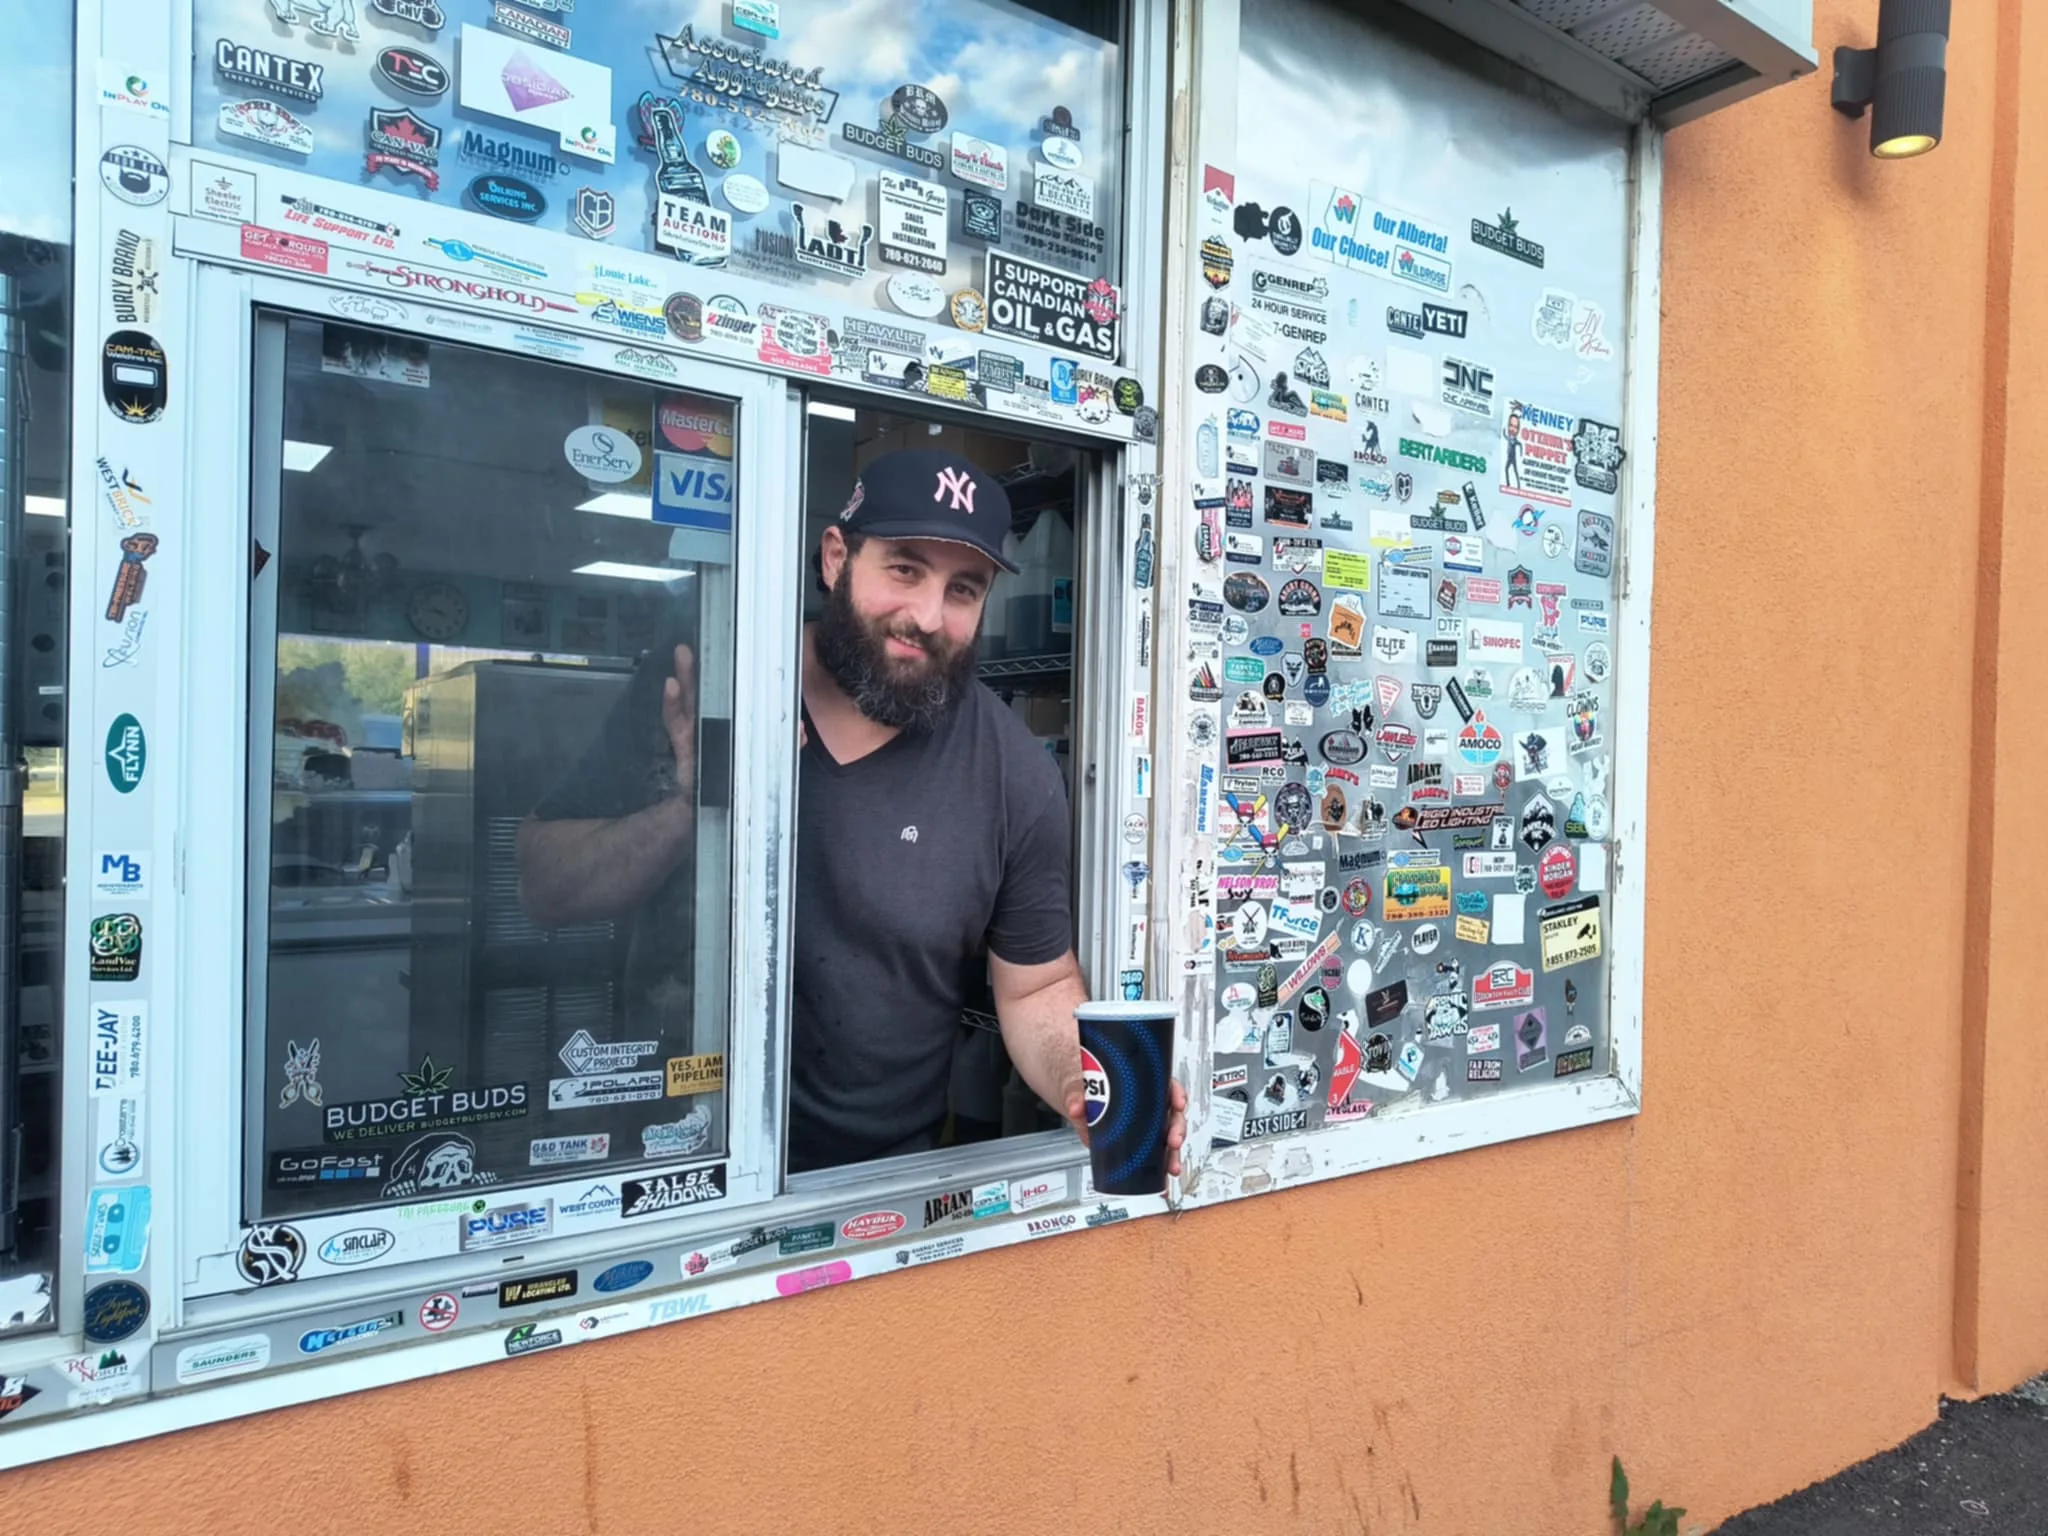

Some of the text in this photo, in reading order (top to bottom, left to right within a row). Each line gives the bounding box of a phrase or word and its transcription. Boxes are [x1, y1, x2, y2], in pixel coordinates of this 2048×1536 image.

[498, 6, 568, 41] CANADIAN
[219, 39, 323, 94] CANTEX
[672, 24, 825, 90] Associated
[464, 130, 556, 173] Magnum
[845, 126, 902, 153] BUDGET
[906, 145, 943, 169] BUDS
[882, 177, 897, 189] The
[205, 196, 241, 210] Electric
[662, 201, 727, 235] TEAM
[1016, 201, 1061, 228] Dark
[1068, 217, 1105, 241] Side
[284, 210, 308, 225] LIFE
[313, 215, 369, 241] SUPPORT
[372, 234, 395, 250] LTD.
[662, 218, 726, 244] AUCTIONS
[901, 222, 927, 237] SERVICE
[1017, 219, 1103, 253] Window Tinting
[1373, 211, 1448, 255] Our Alberta!
[892, 232, 936, 250] INSTALLATION
[1312, 227, 1389, 269] Our Choice!
[1473, 221, 1544, 260] BUDGET BUDS
[109, 229, 140, 324] BURLY BRAND
[994, 260, 1086, 299] I SUPPORT
[1267, 273, 1314, 292] GENREP
[386, 267, 548, 312] STRONGHOLD
[994, 280, 1085, 318] CANADIAN
[617, 310, 666, 328] WIENS
[1252, 298, 1327, 324] 24 HOUR SERVICE
[1424, 308, 1462, 334] YETI
[715, 314, 756, 334] zinger
[844, 320, 923, 347] HEAVYLIFT
[992, 298, 1113, 353] OIL & GAS
[1273, 322, 1327, 344] 7-GENREP
[105, 343, 163, 358] CAM-TAC
[1355, 392, 1390, 413] CANTEX
[1522, 406, 1574, 432] KENNEY
[572, 448, 634, 470] EnerServ
[1354, 450, 1387, 464] BRONCO
[1525, 443, 1568, 464] PUPPET
[671, 469, 732, 504] VIS
[934, 467, 977, 514] NY
[1413, 519, 1467, 532] BUDGET BUDS
[1438, 618, 1461, 631] DTF
[1376, 637, 1406, 649] ELITE
[1483, 636, 1521, 649] SINOPEC
[1376, 729, 1417, 744] LAWLESS
[1459, 738, 1501, 749] AMOCO
[125, 726, 140, 782] FLYNN
[1262, 767, 1285, 776] RCO
[1422, 809, 1449, 818] RIGID
[1440, 816, 1490, 828] LIGHTING
[1339, 850, 1382, 869] Magnum
[1414, 930, 1438, 944] PLAYER
[91, 956, 137, 967] LandVac
[1287, 945, 1327, 990] WILLOWS
[571, 1043, 658, 1057] CUSTOM INTEGRITY
[593, 1056, 636, 1068] PROJECTS
[670, 1060, 693, 1072] YES,
[1469, 1061, 1500, 1071] FAR FROM
[590, 1075, 661, 1088] POLARD
[1469, 1070, 1500, 1079] RELIGION
[327, 1085, 526, 1128] BUDGET BUDS
[334, 1130, 356, 1140] WE
[359, 1122, 415, 1137] DELIVER
[532, 1138, 588, 1153] G&D TANK
[280, 1154, 384, 1171] GoFast
[638, 1168, 715, 1196] FALSE
[559, 1202, 586, 1214] WEST
[624, 1183, 723, 1215] SHADOWS
[468, 1208, 547, 1236] PURE
[1028, 1215, 1076, 1233] BRONCO
[522, 1283, 558, 1299] LOCATING
[648, 1294, 712, 1322] TBWL
[192, 1351, 256, 1369] SAUNDERS
